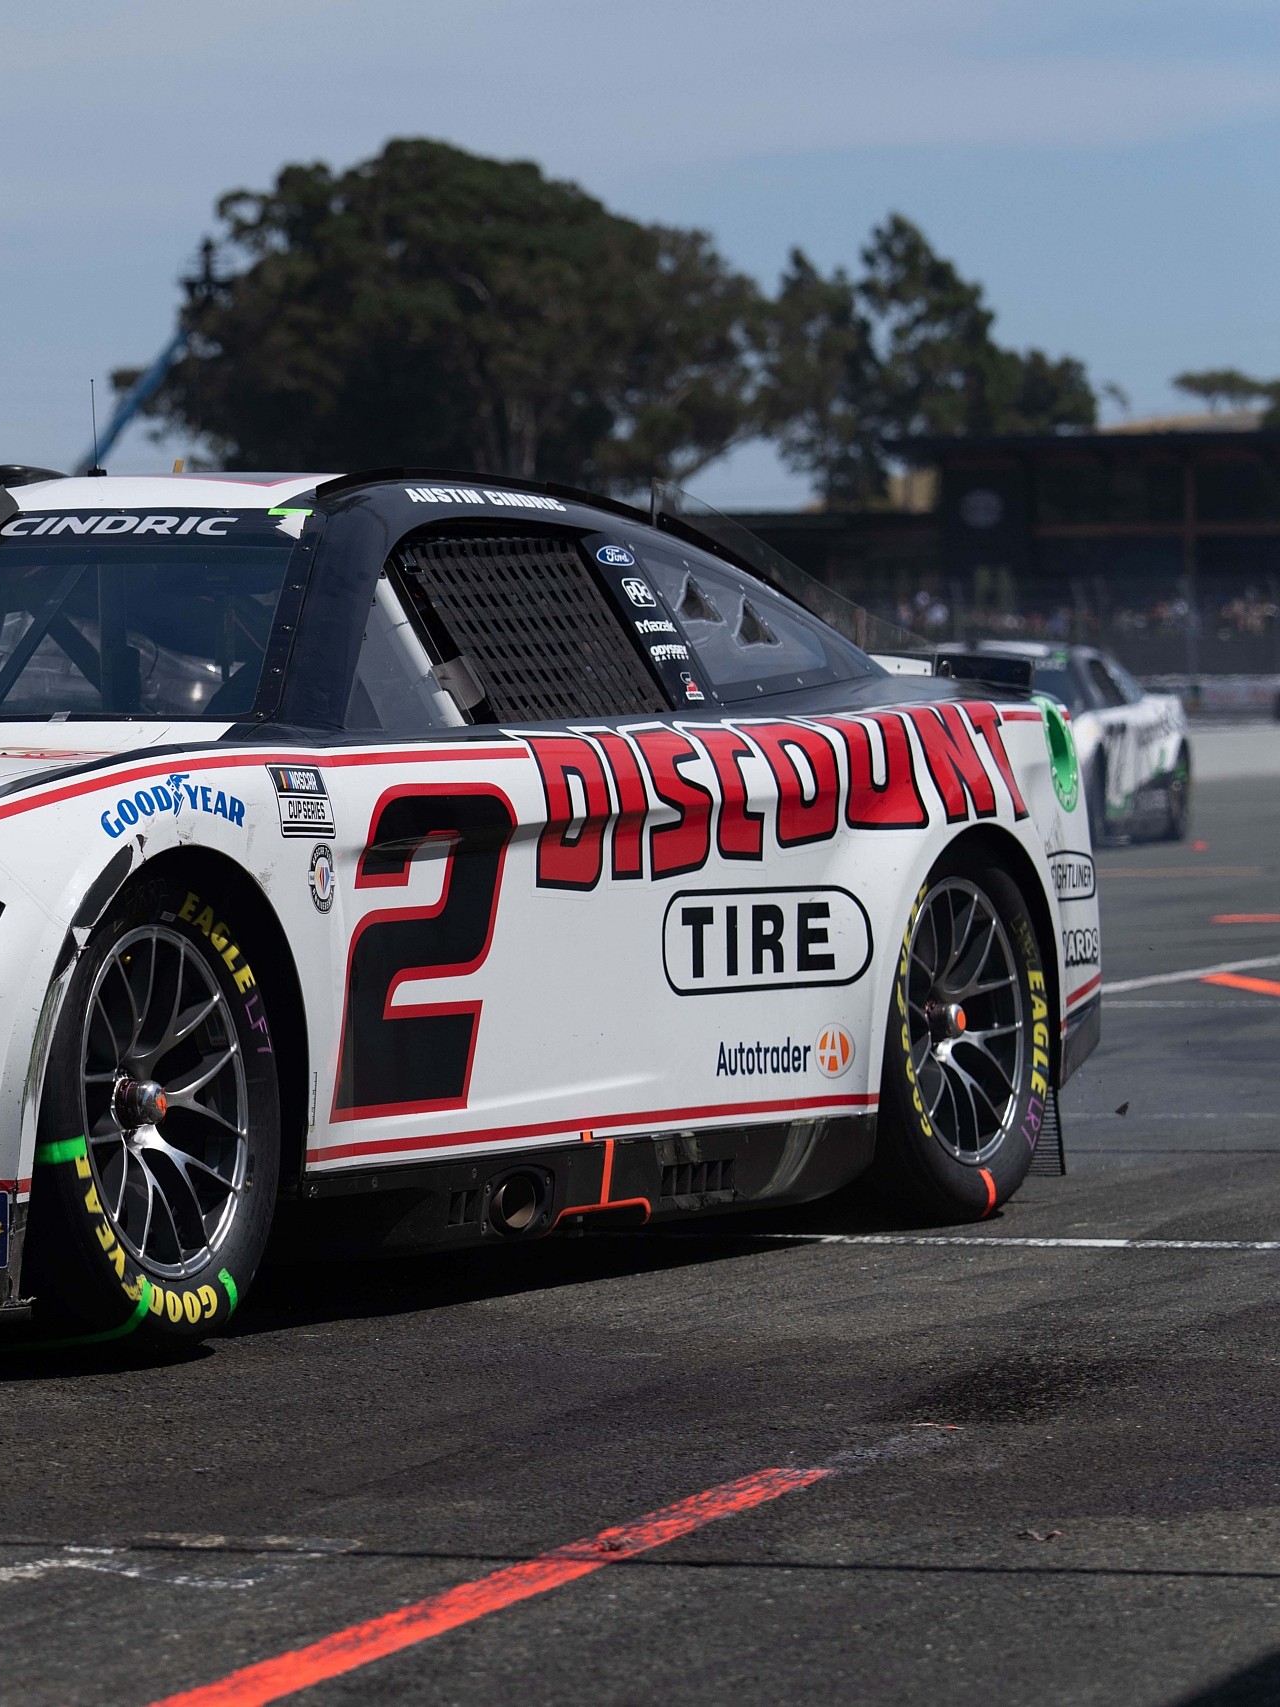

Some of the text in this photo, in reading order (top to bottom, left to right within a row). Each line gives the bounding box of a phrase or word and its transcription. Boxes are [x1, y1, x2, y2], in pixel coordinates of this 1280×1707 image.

[405, 488, 567, 512] AUSTIN CINDRIC
[0, 515, 239, 536] CINDRIC
[606, 548, 630, 563] Ford
[634, 619, 677, 634] Mazak
[650, 644, 688, 656] ODYSSEY
[288, 800, 326, 820] CUP SERIES
[526, 700, 1029, 891] DISCOUNT
[178, 891, 257, 995] EAGLE
[329, 782, 518, 1124] 2
[681, 902, 836, 979] TIRE
[1027, 970, 1049, 1101] EAGLE
[716, 1036, 812, 1077] Autotrader
